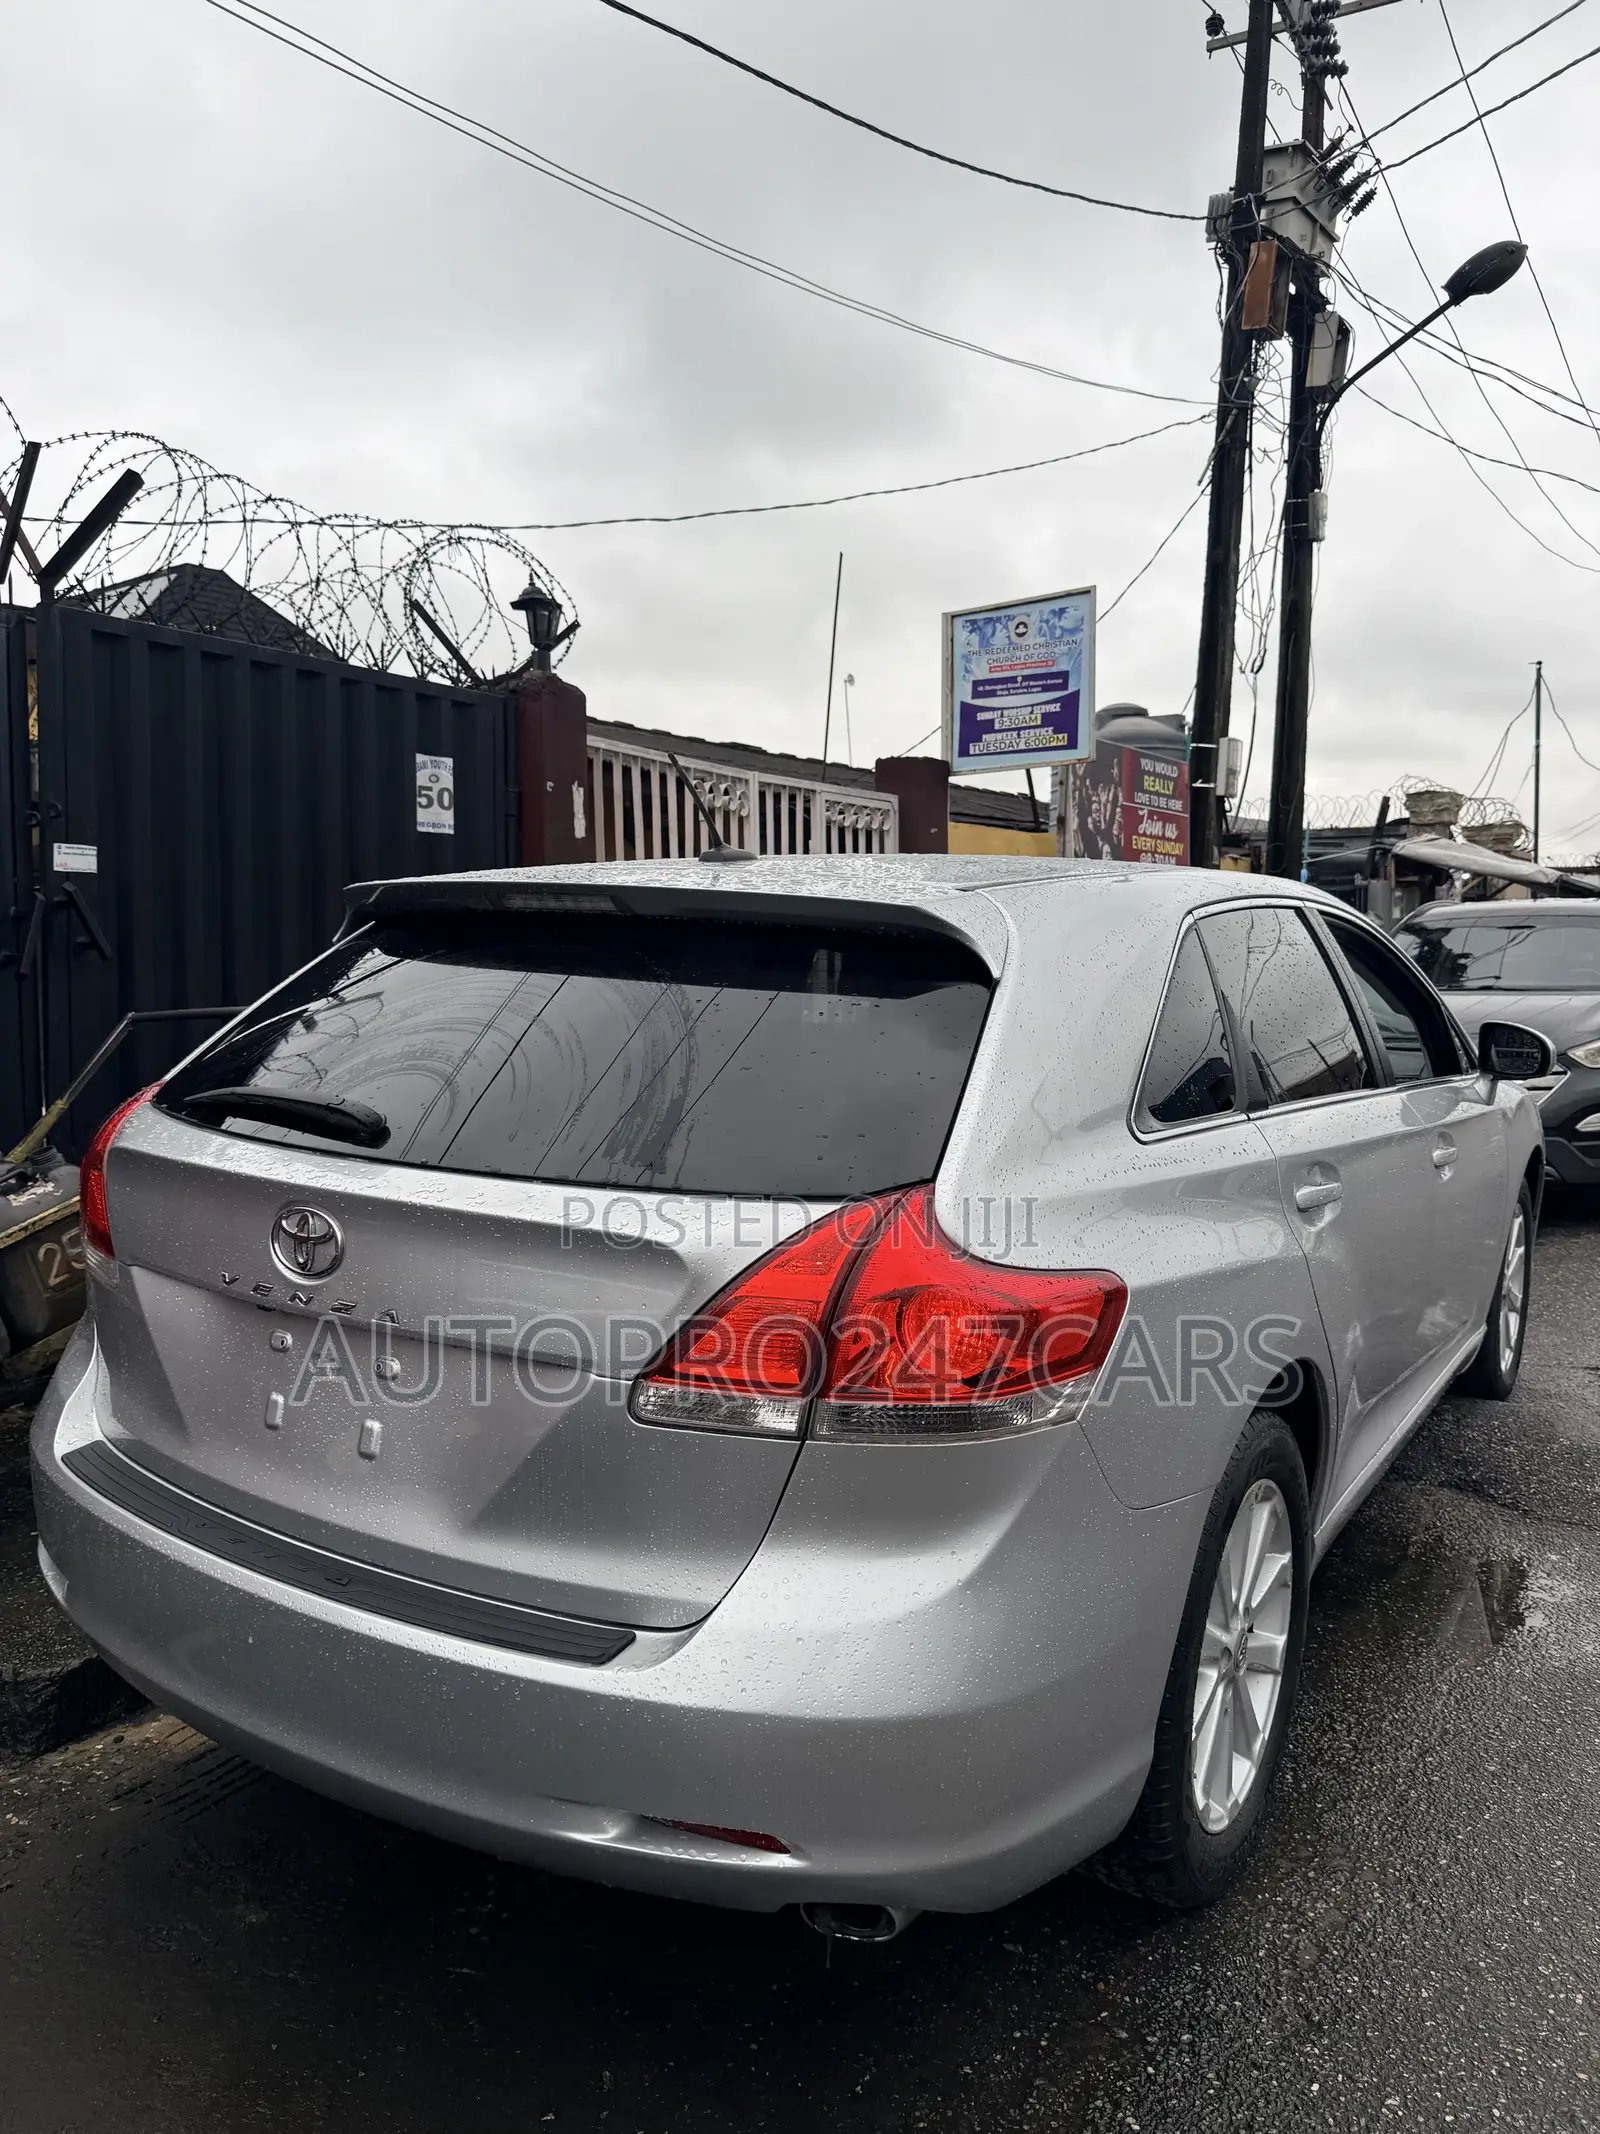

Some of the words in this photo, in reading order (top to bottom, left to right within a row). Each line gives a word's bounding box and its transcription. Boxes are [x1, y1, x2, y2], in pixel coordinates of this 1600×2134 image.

[968, 649, 983, 657] THE
[985, 645, 1031, 656] REDEEMED
[1033, 639, 1078, 650] CHRISTIAN
[987, 655, 1021, 666] CHURCH
[1023, 653, 1035, 661] OF
[1037, 651, 1056, 660] GOD
[976, 710, 1001, 721] SUNDAY
[1003, 706, 1030, 718] WORSHIP
[1032, 702, 1061, 714] SERVICE
[998, 715, 1039, 728] 9:30AM
[982, 730, 1018, 742] MIDWEEK
[1019, 726, 1054, 739] SERVICE
[971, 741, 1021, 754] TUESDAY
[1024, 735, 1066, 747] 6:00PM
[1140, 758, 1154, 772] YOU
[1155, 760, 1178, 778] WOULD
[1143, 775, 1174, 796] REALLY
[417, 785, 453, 811] 50
[1134, 792, 1150, 804] LOVE
[1150, 794, 1158, 807] TO
[1159, 797, 1168, 808] BE
[1167, 799, 1183, 812] HERE
[1137, 807, 1164, 838] Join
[1164, 821, 1179, 840] us
[1132, 835, 1157, 852] EVERY
[1156, 837, 1184, 856] SUNDAY
[221, 1270, 400, 1326] VENZA
